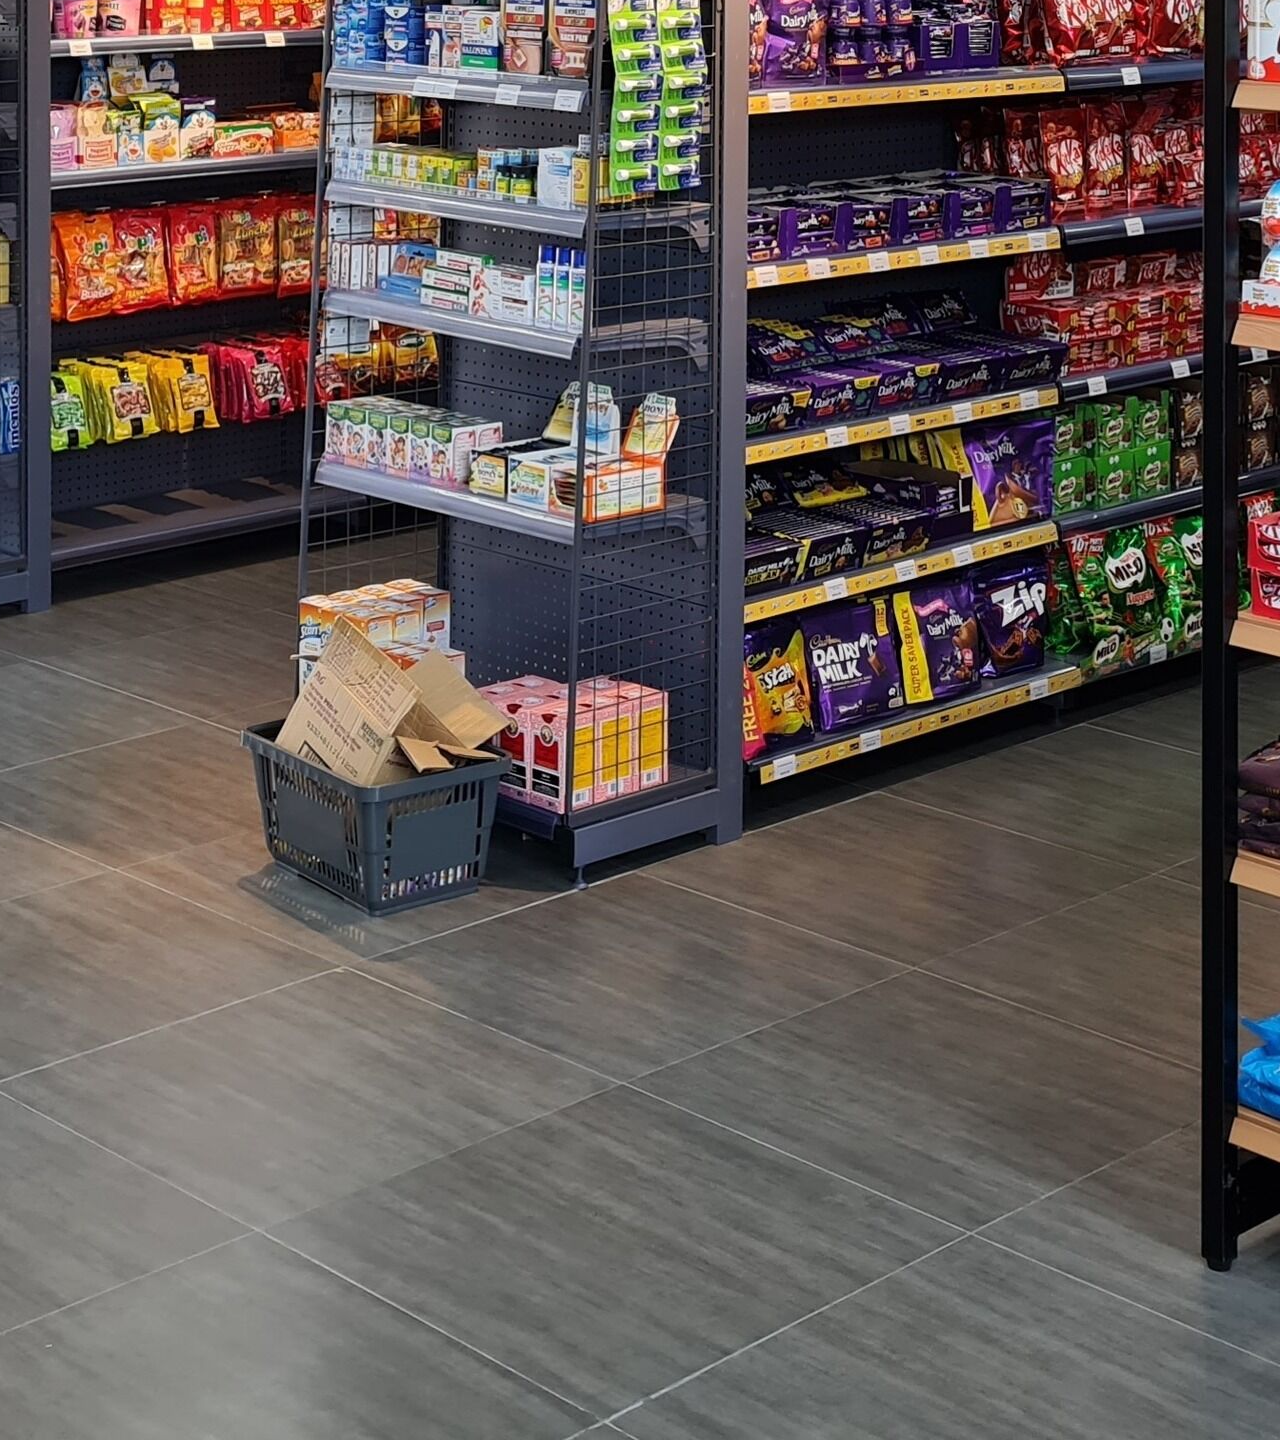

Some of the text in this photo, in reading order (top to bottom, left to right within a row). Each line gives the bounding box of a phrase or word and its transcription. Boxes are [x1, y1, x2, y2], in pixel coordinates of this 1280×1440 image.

[781, 15, 807, 27] Dairy
[9, 384, 20, 449] mentos
[973, 437, 1018, 463] Dairy Milk
[1110, 556, 1143, 583] MILO
[991, 581, 1046, 627] Zip
[927, 610, 962, 636] Dairy Milk
[812, 641, 859, 666] DAIRY
[901, 608, 921, 694] SUPER SAVER PACK
[819, 660, 861, 684] MILK
